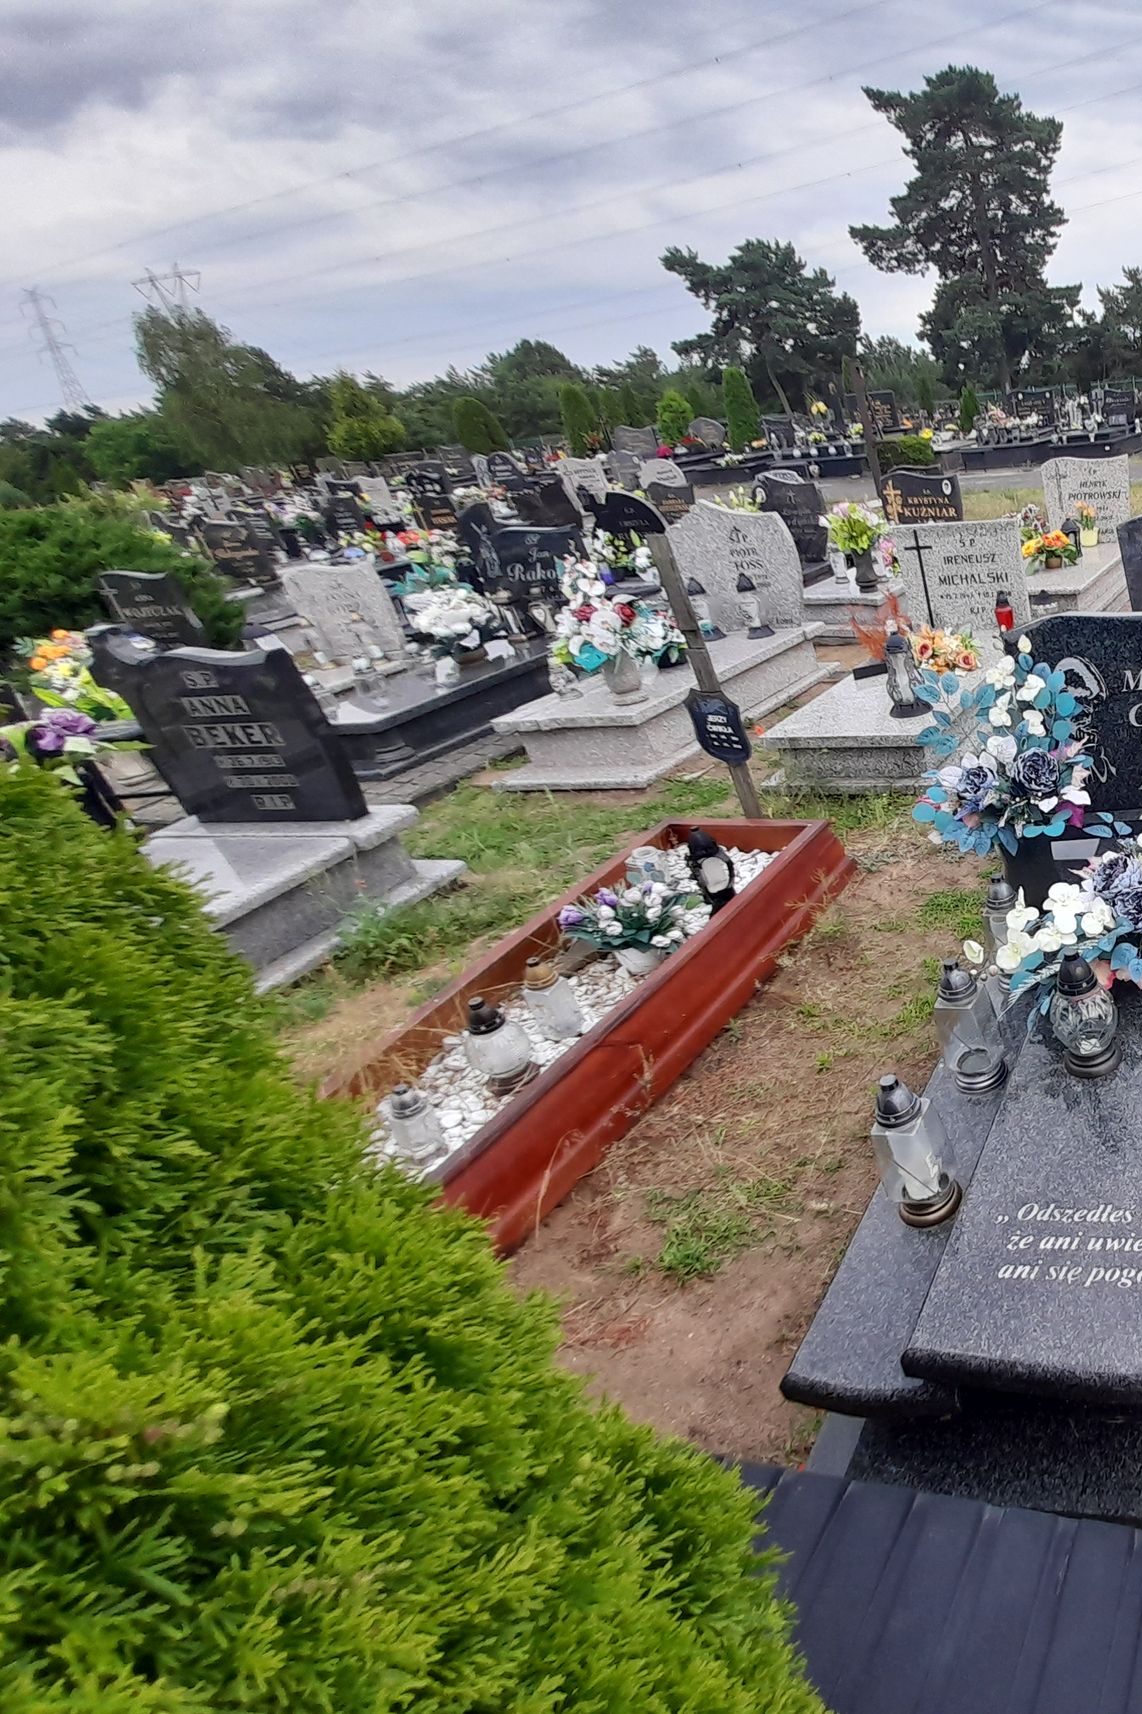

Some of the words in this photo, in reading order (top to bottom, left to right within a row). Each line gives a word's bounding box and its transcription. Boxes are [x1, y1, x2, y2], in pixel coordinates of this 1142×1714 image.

[1068, 490, 1121, 501] PIOTROWSKI
[528, 547, 549, 563] Jan
[943, 552, 997, 566] IRENEUSZ
[506, 562, 557, 583] Rako
[938, 572, 1009, 587] MICHALSKI
[184, 696, 248, 716] ANNA
[182, 724, 286, 747] BEKER
[1006, 1230, 1035, 1251] że
[1038, 1231, 1084, 1251] ani
[997, 1259, 1044, 1280] ani
[1045, 1261, 1084, 1285] się
